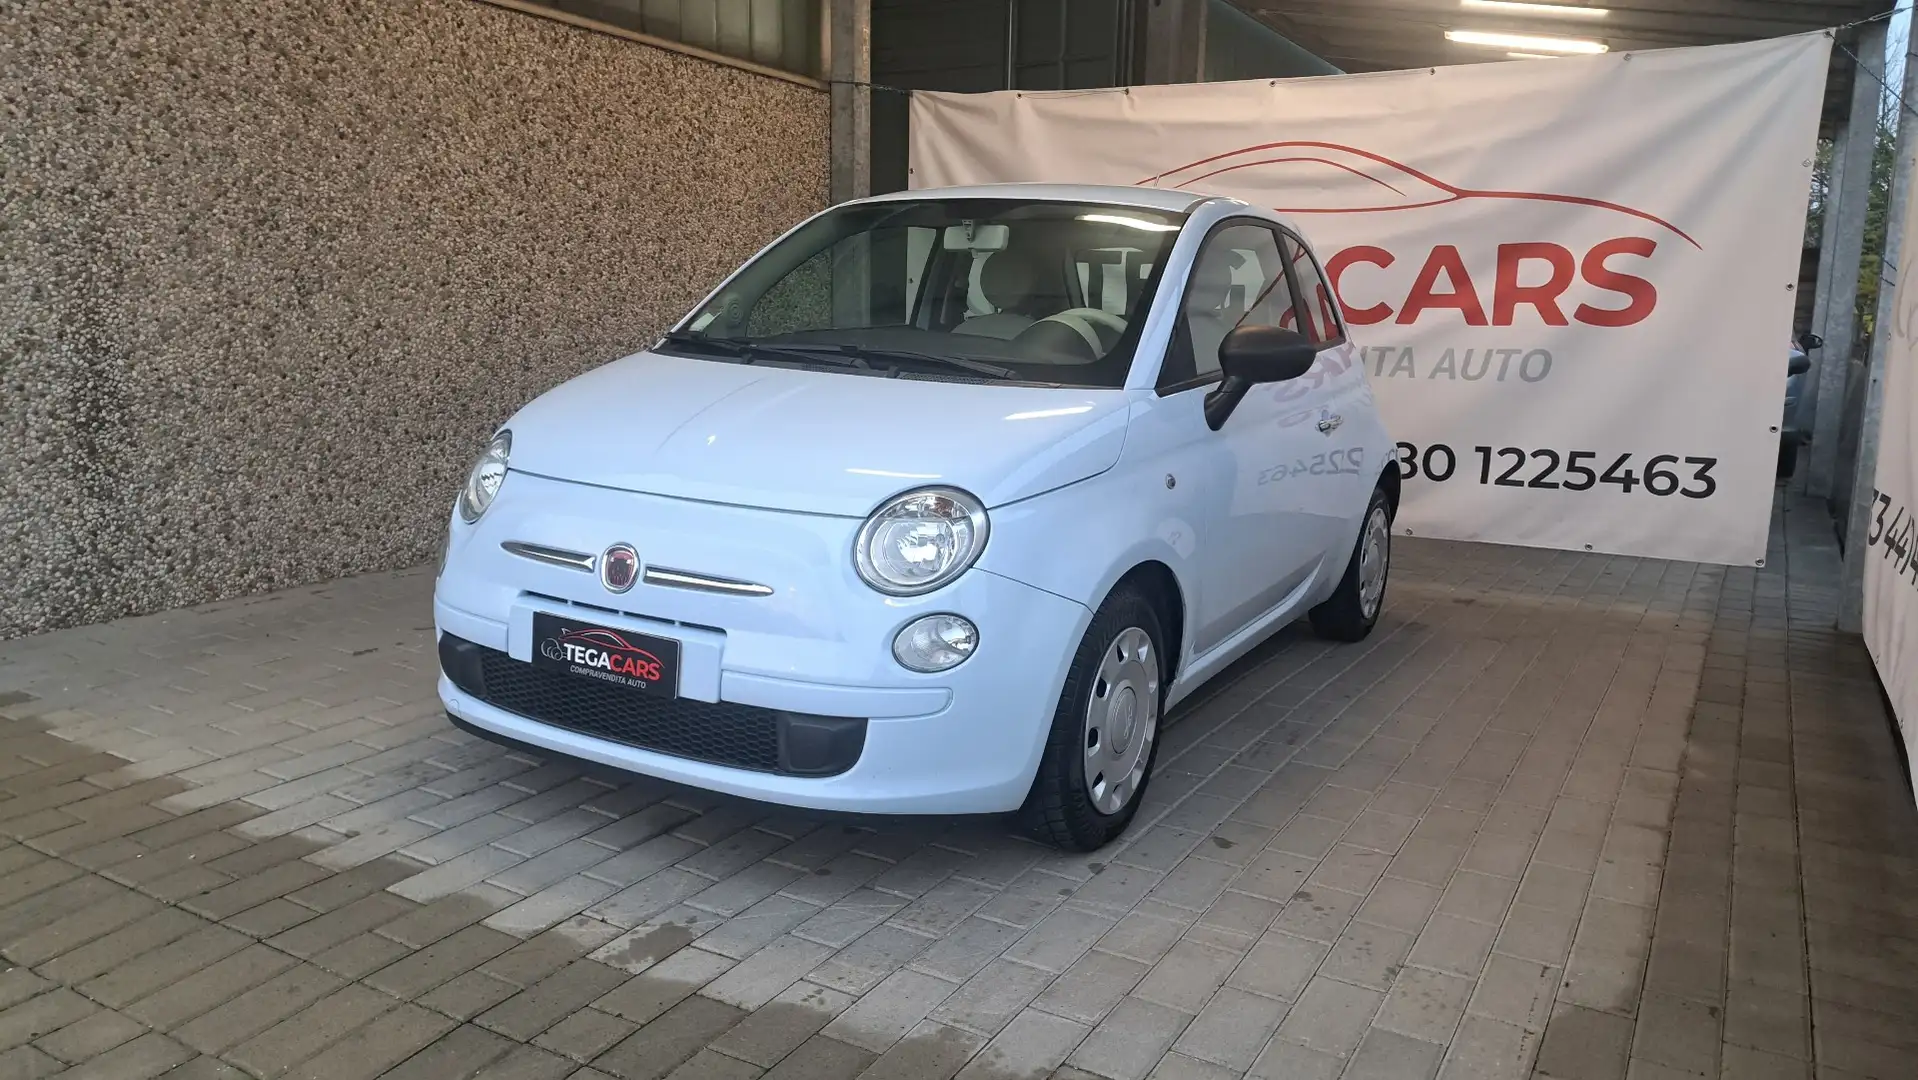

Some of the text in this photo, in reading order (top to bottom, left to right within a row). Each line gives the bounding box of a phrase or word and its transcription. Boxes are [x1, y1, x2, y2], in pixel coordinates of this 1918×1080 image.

[1324, 236, 1658, 328] CARS
[1428, 347, 1553, 384] AUTO
[1474, 445, 1718, 500] 1225463
[563, 642, 661, 681] TEGACARS
[570, 665, 646, 689] COMPRAVENDITA AUTO
